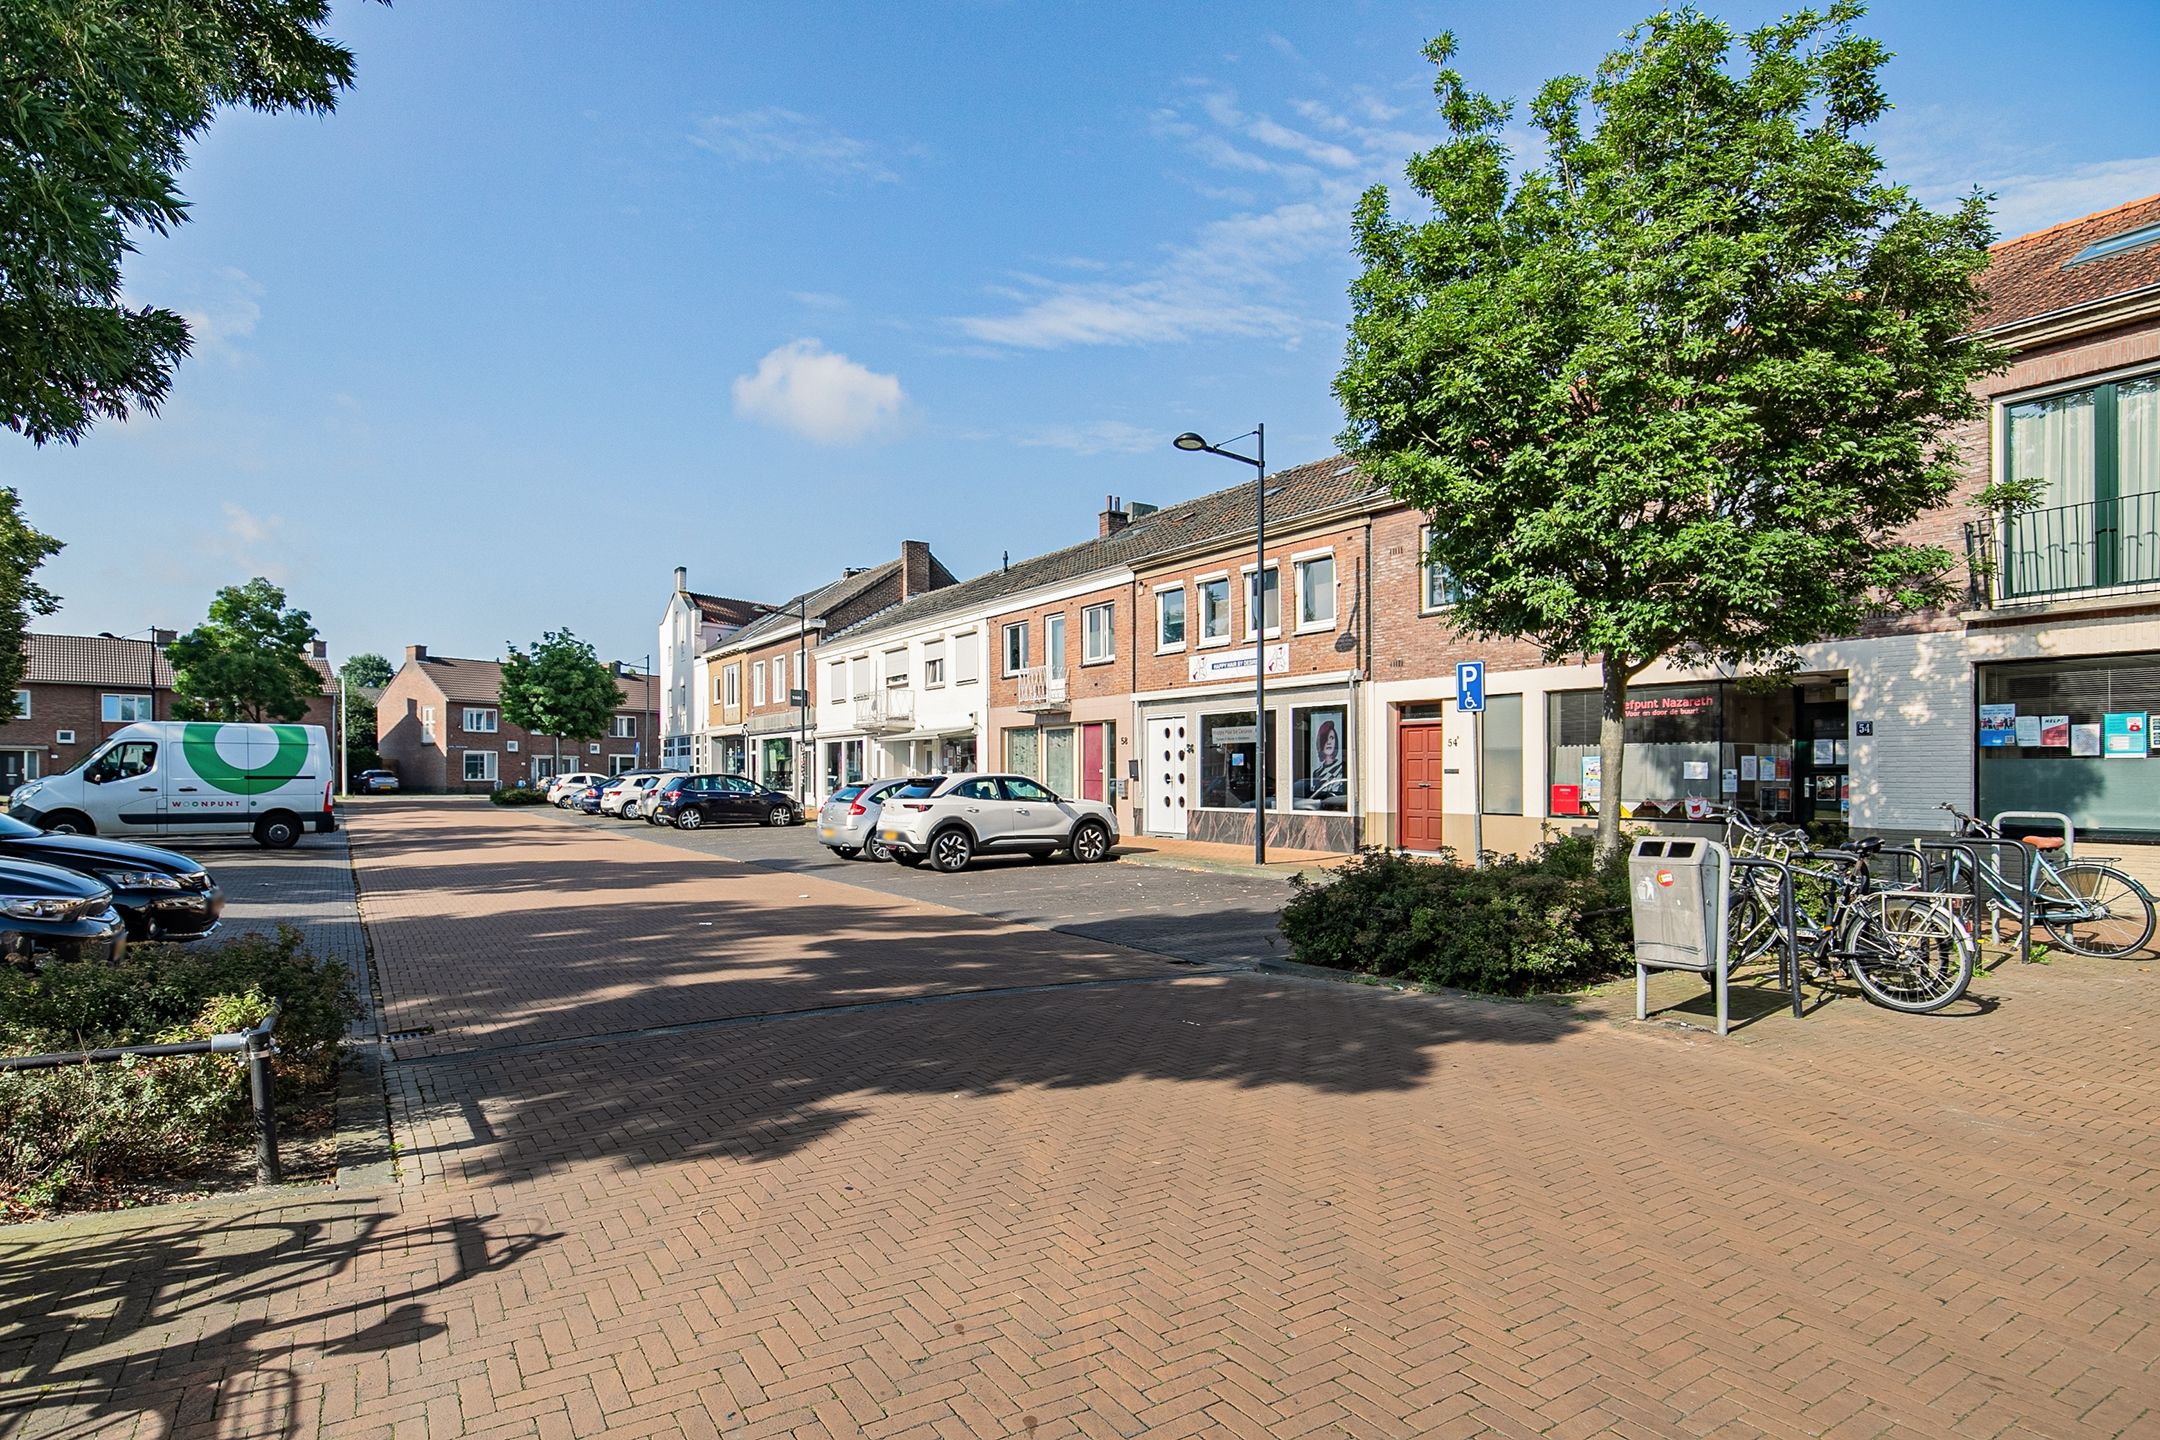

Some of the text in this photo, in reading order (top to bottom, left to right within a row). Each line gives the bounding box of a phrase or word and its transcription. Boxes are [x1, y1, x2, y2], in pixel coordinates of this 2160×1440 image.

[1462, 666, 1477, 691] P
[1625, 696, 1713, 710] efpunt Nazareth
[1652, 708, 1667, 716] door
[1680, 707, 1699, 715] buurt
[1858, 723, 1870, 734] 54
[1121, 737, 1128, 745] 58
